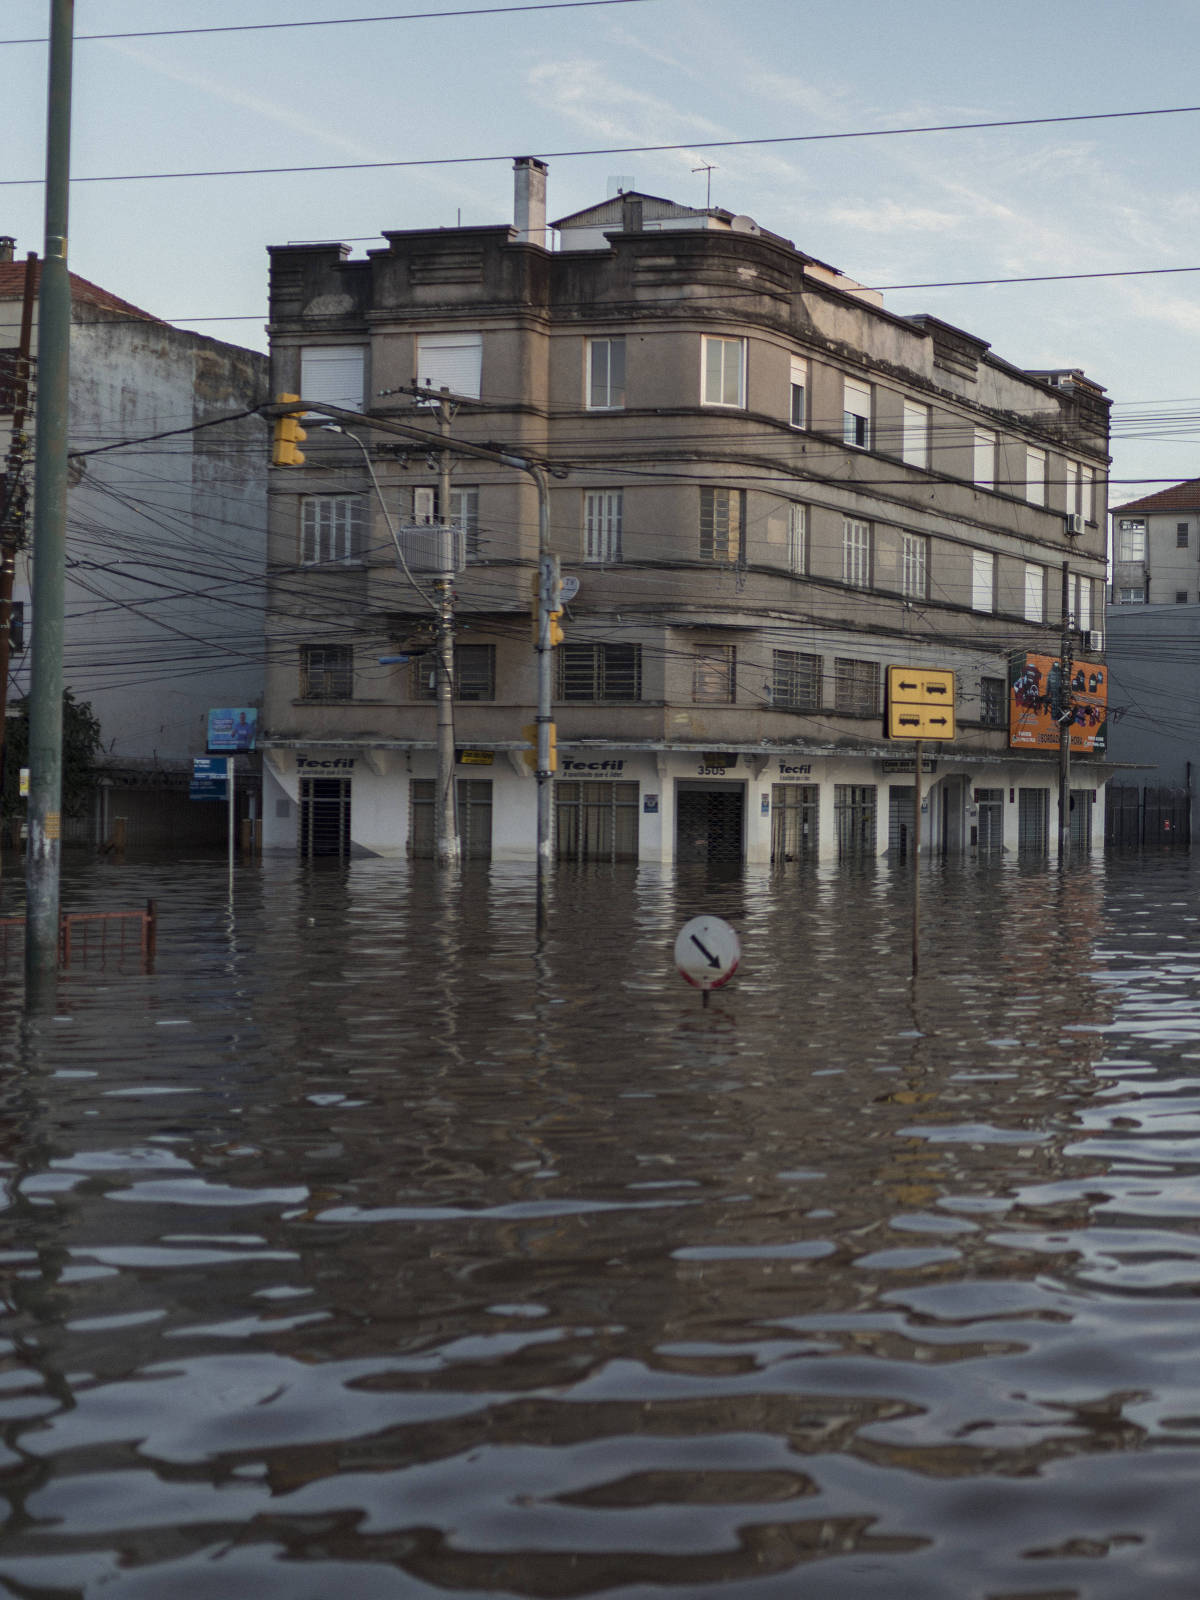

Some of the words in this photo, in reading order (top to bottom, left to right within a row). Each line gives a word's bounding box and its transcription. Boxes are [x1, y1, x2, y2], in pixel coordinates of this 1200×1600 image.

[296, 758, 355, 768] Tecfil
[561, 760, 624, 770] Tecfil
[697, 765, 726, 776] 3505
[779, 764, 811, 774] Tecfil
